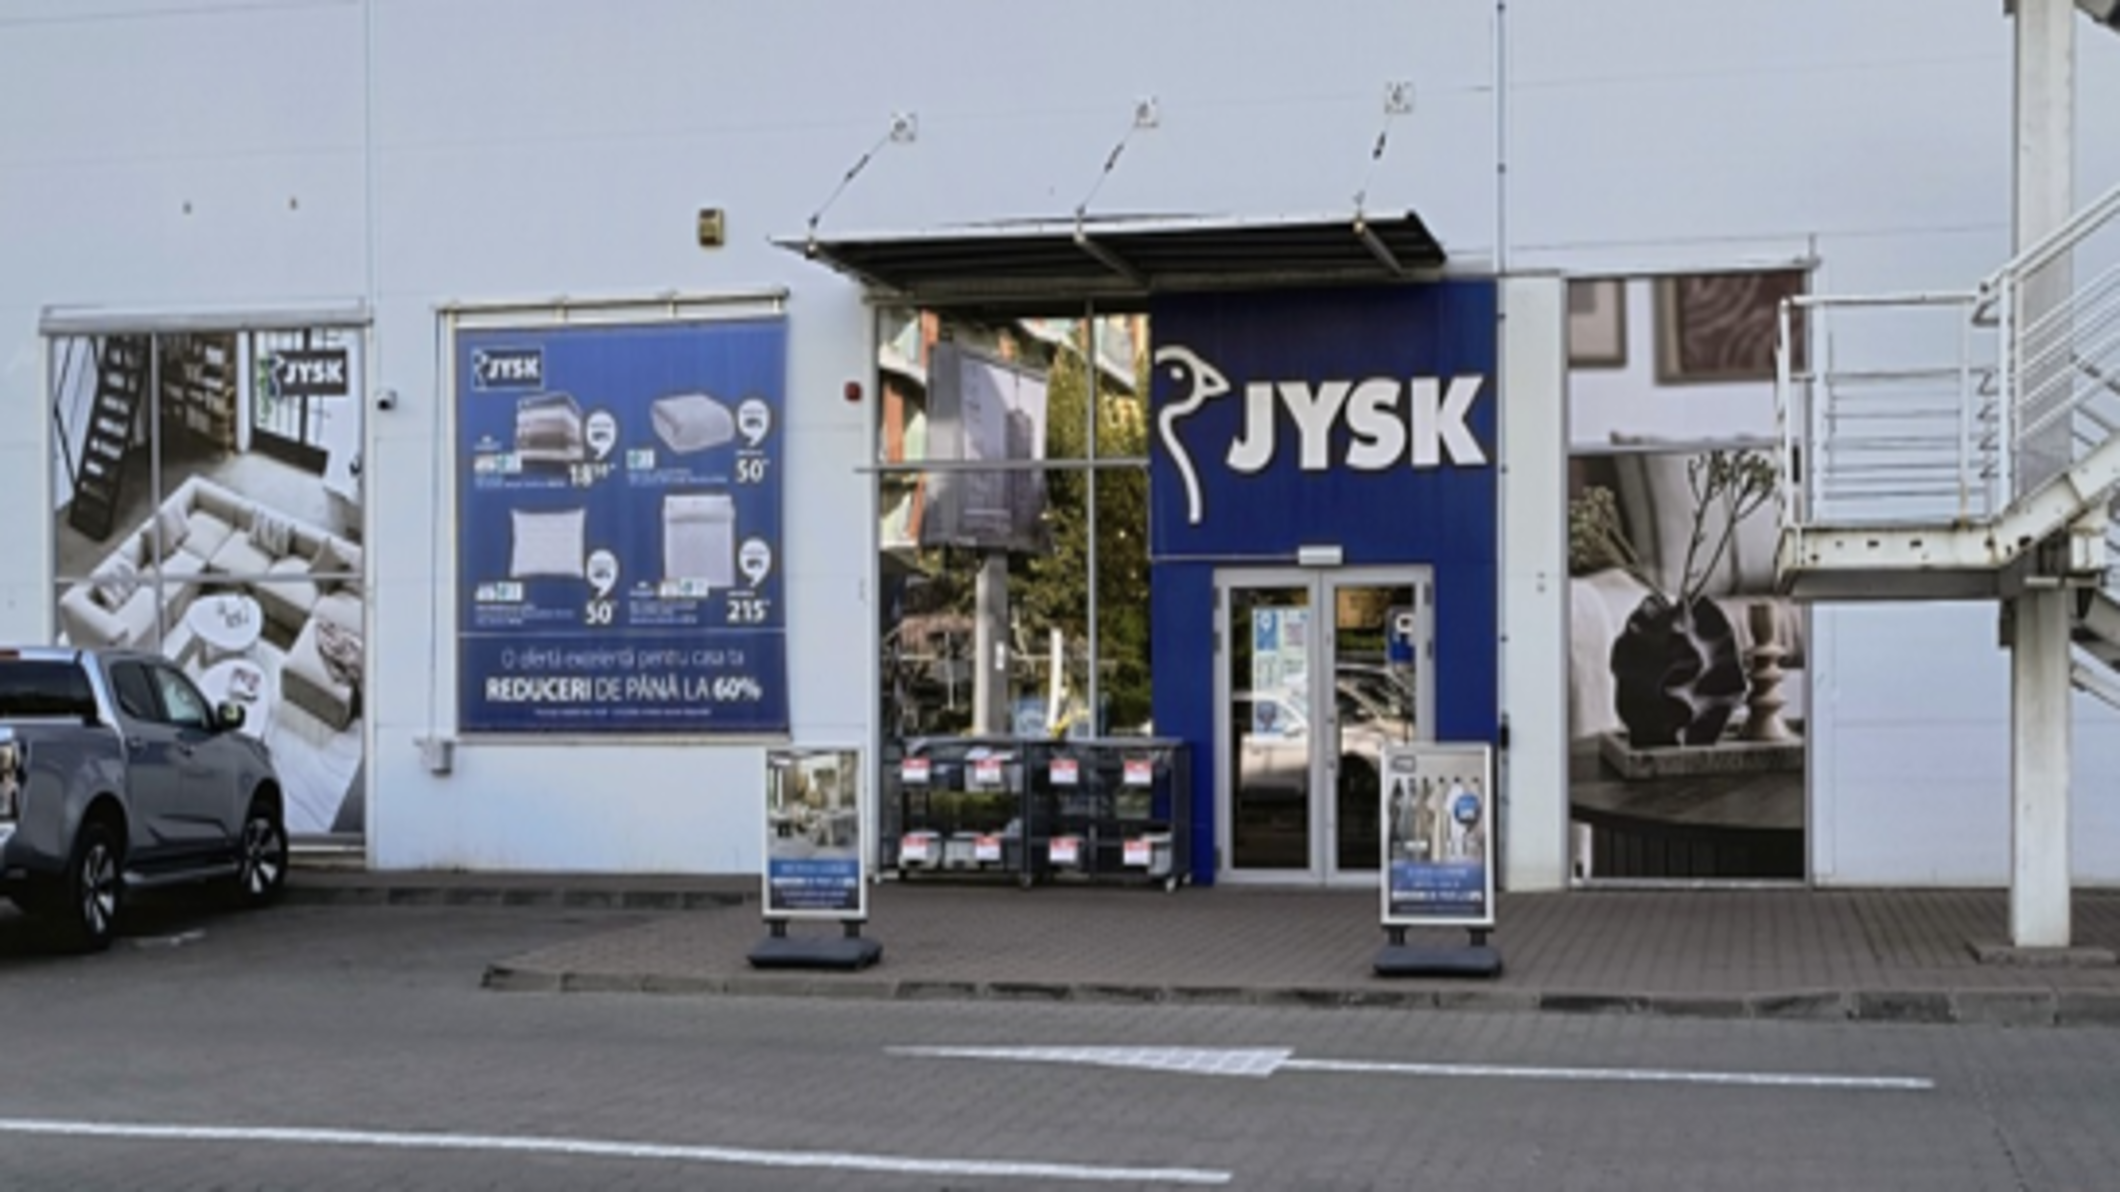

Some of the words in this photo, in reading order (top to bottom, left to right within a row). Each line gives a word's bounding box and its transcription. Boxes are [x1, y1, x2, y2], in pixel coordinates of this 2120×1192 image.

[283, 360, 343, 384] JYSK
[488, 358, 538, 380] JYSK
[1226, 375, 1488, 473] JYSK
[501, 647, 514, 670] O
[638, 649, 689, 671] pentru
[692, 651, 725, 668] casa
[485, 677, 592, 702] REDUCERI
[595, 677, 622, 701] DE
[626, 672, 680, 701] PÂNĂ
[684, 677, 709, 701] LA
[712, 676, 763, 702] 60%
